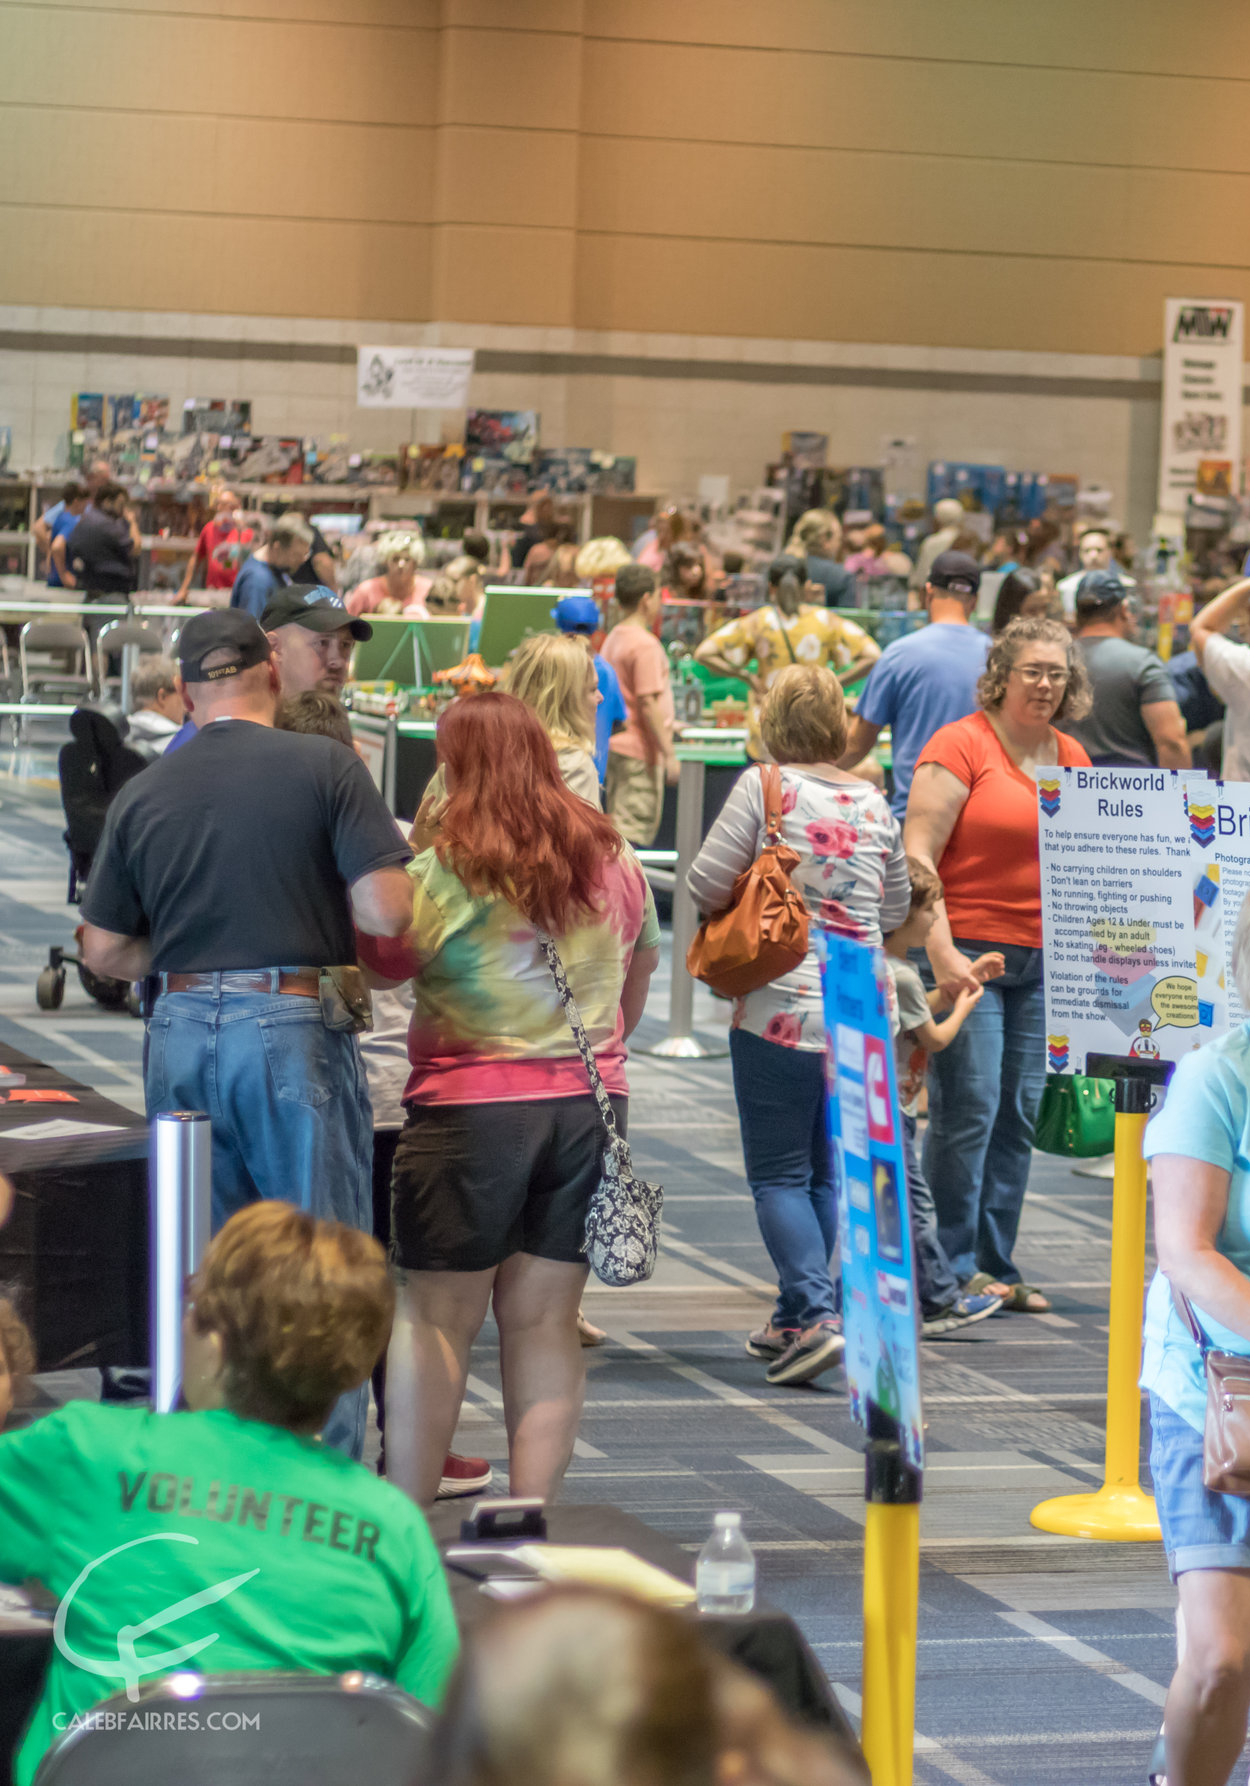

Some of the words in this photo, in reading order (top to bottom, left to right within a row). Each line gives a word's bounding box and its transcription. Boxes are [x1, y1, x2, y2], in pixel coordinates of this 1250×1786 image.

[1077, 771, 1165, 792] Brickworld
[1098, 798, 1144, 818] Rules
[1044, 829, 1054, 839] To
[1055, 829, 1072, 841] help
[1074, 832, 1100, 841] ensure
[1102, 832, 1138, 844] everyone
[1140, 832, 1154, 843] has
[1156, 833, 1172, 844] fun,
[1174, 836, 1186, 844] we
[1044, 842, 1059, 852] that
[1060, 844, 1076, 854] you
[1077, 843, 1104, 853] adhere
[1105, 845, 1114, 854] to
[1115, 845, 1138, 855] these
[1139, 846, 1162, 856] rules.
[1166, 847, 1191, 857] Thank
[1050, 863, 1061, 872] No
[1063, 864, 1095, 876] carrying
[1096, 865, 1128, 875] children
[1130, 868, 1140, 876] on
[1142, 867, 1182, 878] shoulders
[1222, 867, 1242, 876] Please
[1051, 875, 1071, 886] Don't
[1073, 876, 1089, 886] lean
[1091, 879, 1101, 887] on
[1102, 878, 1133, 889] barriers
[1051, 888, 1062, 898] No
[1097, 890, 1128, 903] fighting
[1140, 893, 1172, 905] pushing
[1052, 901, 1063, 910] No
[1064, 902, 1098, 914] throwing
[1099, 904, 1128, 915] objects
[1052, 914, 1084, 924] Children
[1086, 916, 1106, 927] Ages
[1108, 917, 1117, 926] 12
[1127, 918, 1151, 928] Under
[1152, 920, 1173, 929] must
[1174, 920, 1185, 930] be
[1054, 928, 1105, 940] accompanied
[1107, 930, 1117, 940] by
[1119, 932, 1129, 940] an
[1130, 930, 1151, 941] adult
[1053, 939, 1064, 949] No
[1065, 940, 1094, 953] skating
[1095, 942, 1108, 954] (eg
[1115, 943, 1147, 954] wheeled
[1148, 945, 1176, 957] shoes)
[1053, 952, 1065, 961] Do
[1066, 953, 1079, 962] not
[1080, 953, 1107, 964] handle
[1108, 955, 1141, 968] displays
[1143, 957, 1170, 967] unless
[1049, 971, 1084, 982] Violation
[1085, 973, 1093, 982] of
[1094, 974, 1108, 983] the
[1109, 975, 1129, 984] rules
[1050, 986, 1065, 994] can
[1066, 985, 1076, 995] be
[1077, 986, 1110, 998] grounds
[1111, 987, 1123, 997] for
[1155, 993, 1183, 1001] everyone
[1051, 996, 1091, 1007] immediate
[1092, 998, 1130, 1010] dismissal
[1051, 1009, 1070, 1018] from
[1071, 1010, 1084, 1020] the
[1085, 1011, 1108, 1021] show.
[117, 1471, 381, 1563] VOLUNTEER
